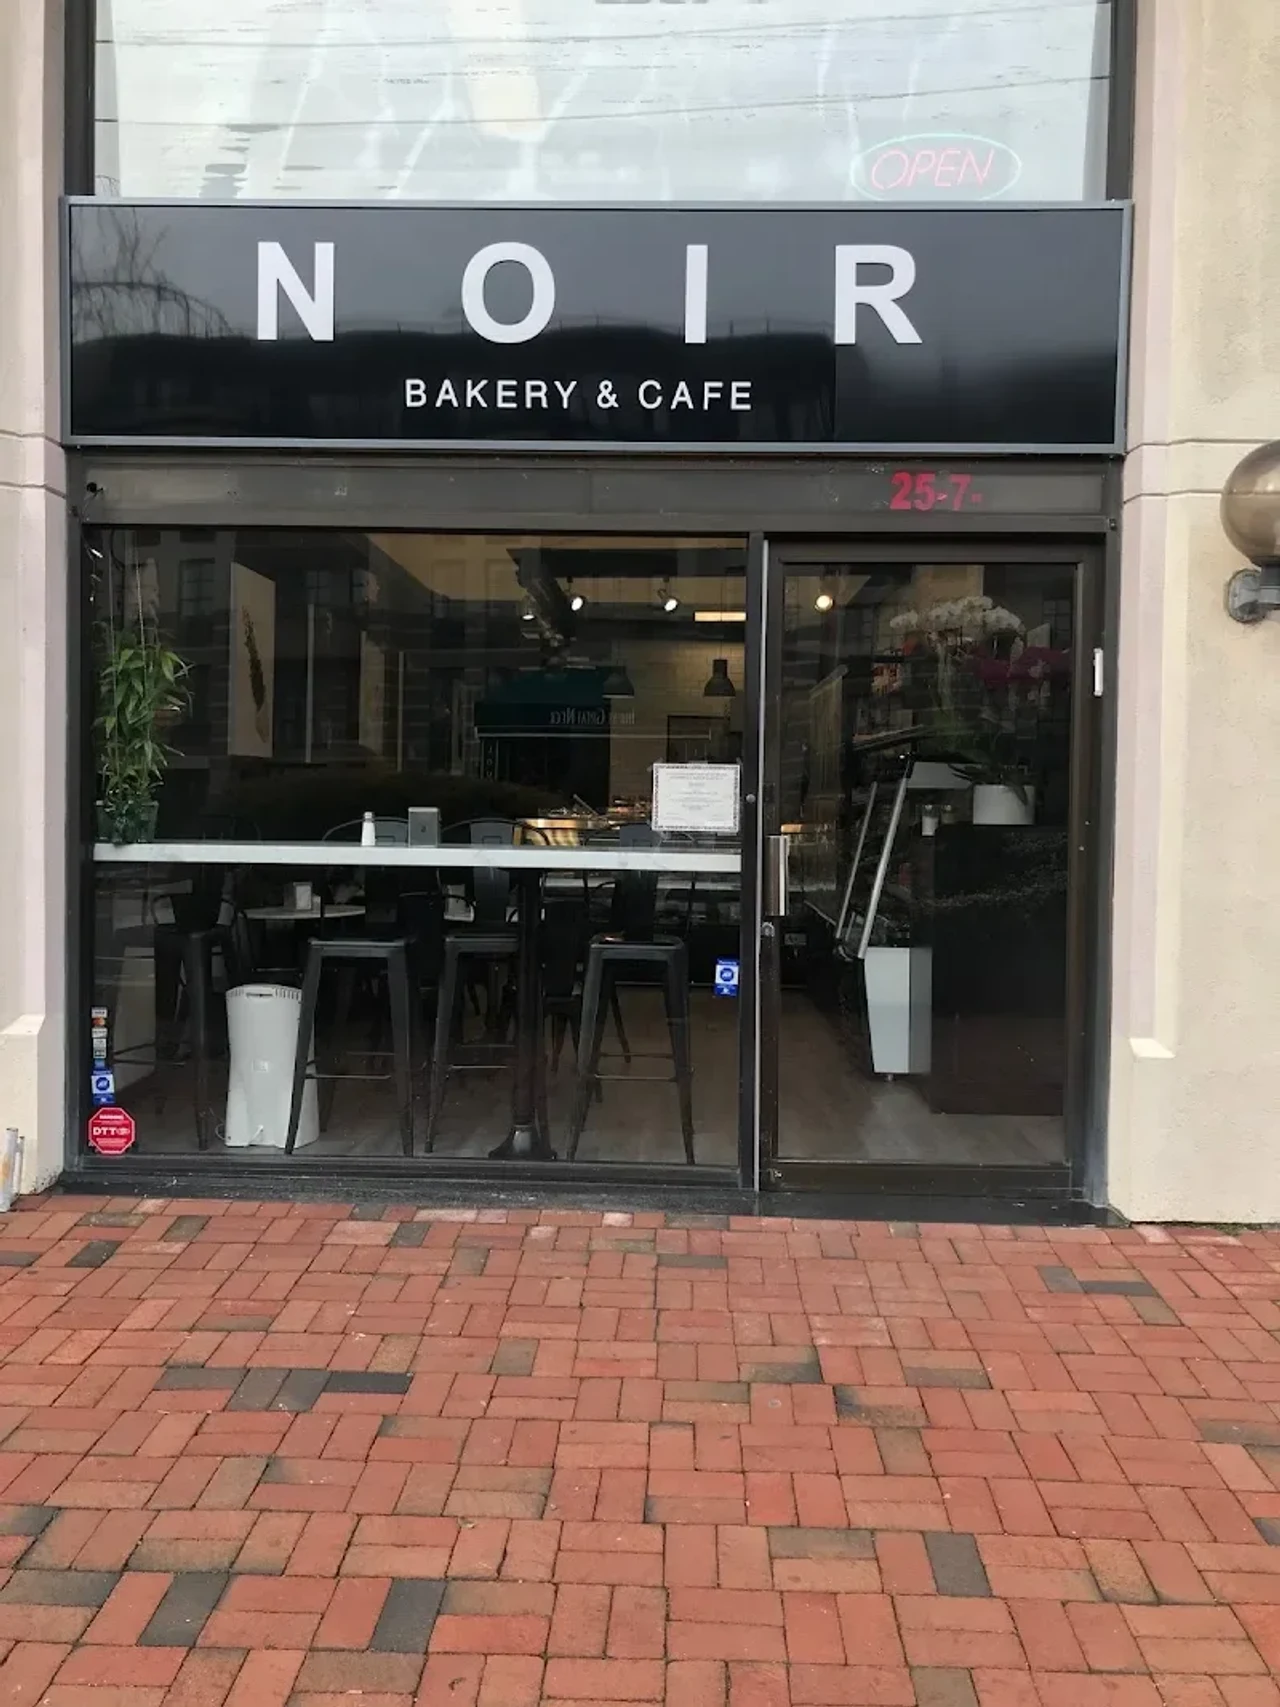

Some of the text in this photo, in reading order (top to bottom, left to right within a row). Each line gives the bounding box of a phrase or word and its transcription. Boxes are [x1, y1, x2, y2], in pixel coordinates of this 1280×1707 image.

[871, 147, 995, 190] OPEN
[257, 240, 923, 345] NOIR
[405, 378, 753, 412] BAKERY & CAFE
